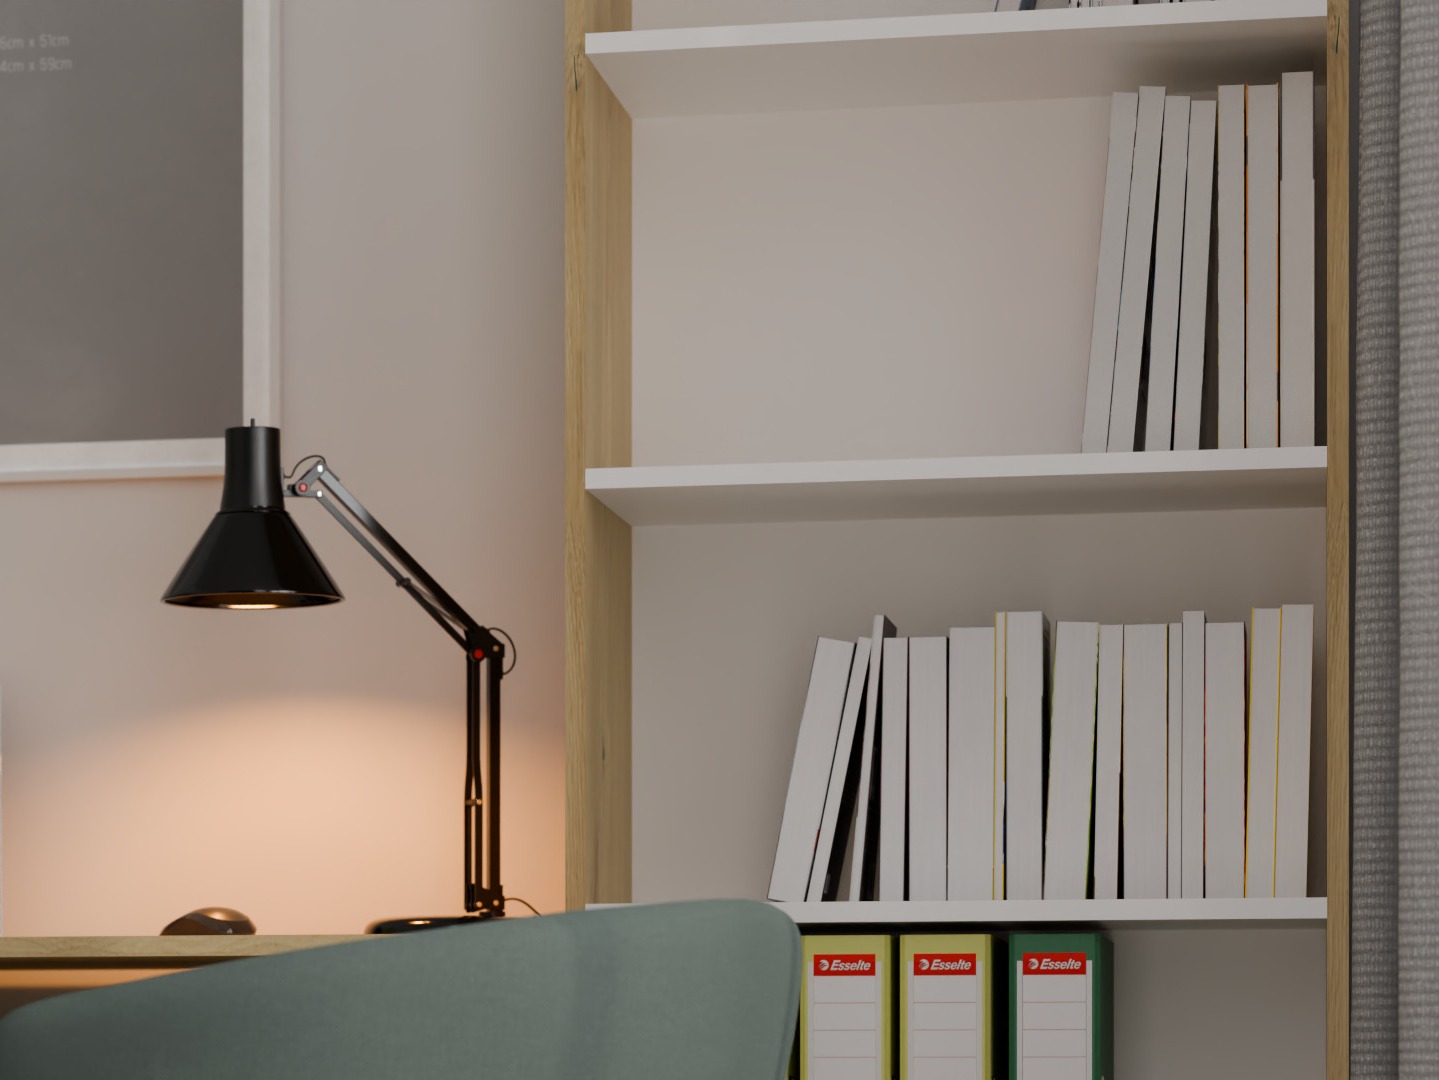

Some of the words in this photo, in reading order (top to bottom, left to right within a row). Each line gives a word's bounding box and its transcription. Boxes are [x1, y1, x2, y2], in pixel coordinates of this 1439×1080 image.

[29, 38, 35, 48] x
[39, 33, 70, 48] 51cm
[29, 62, 35, 71] x
[39, 57, 73, 72] 59cm
[830, 960, 871, 970] Esselte
[931, 959, 971, 970] Esselte
[1040, 959, 1081, 969] Esselte
